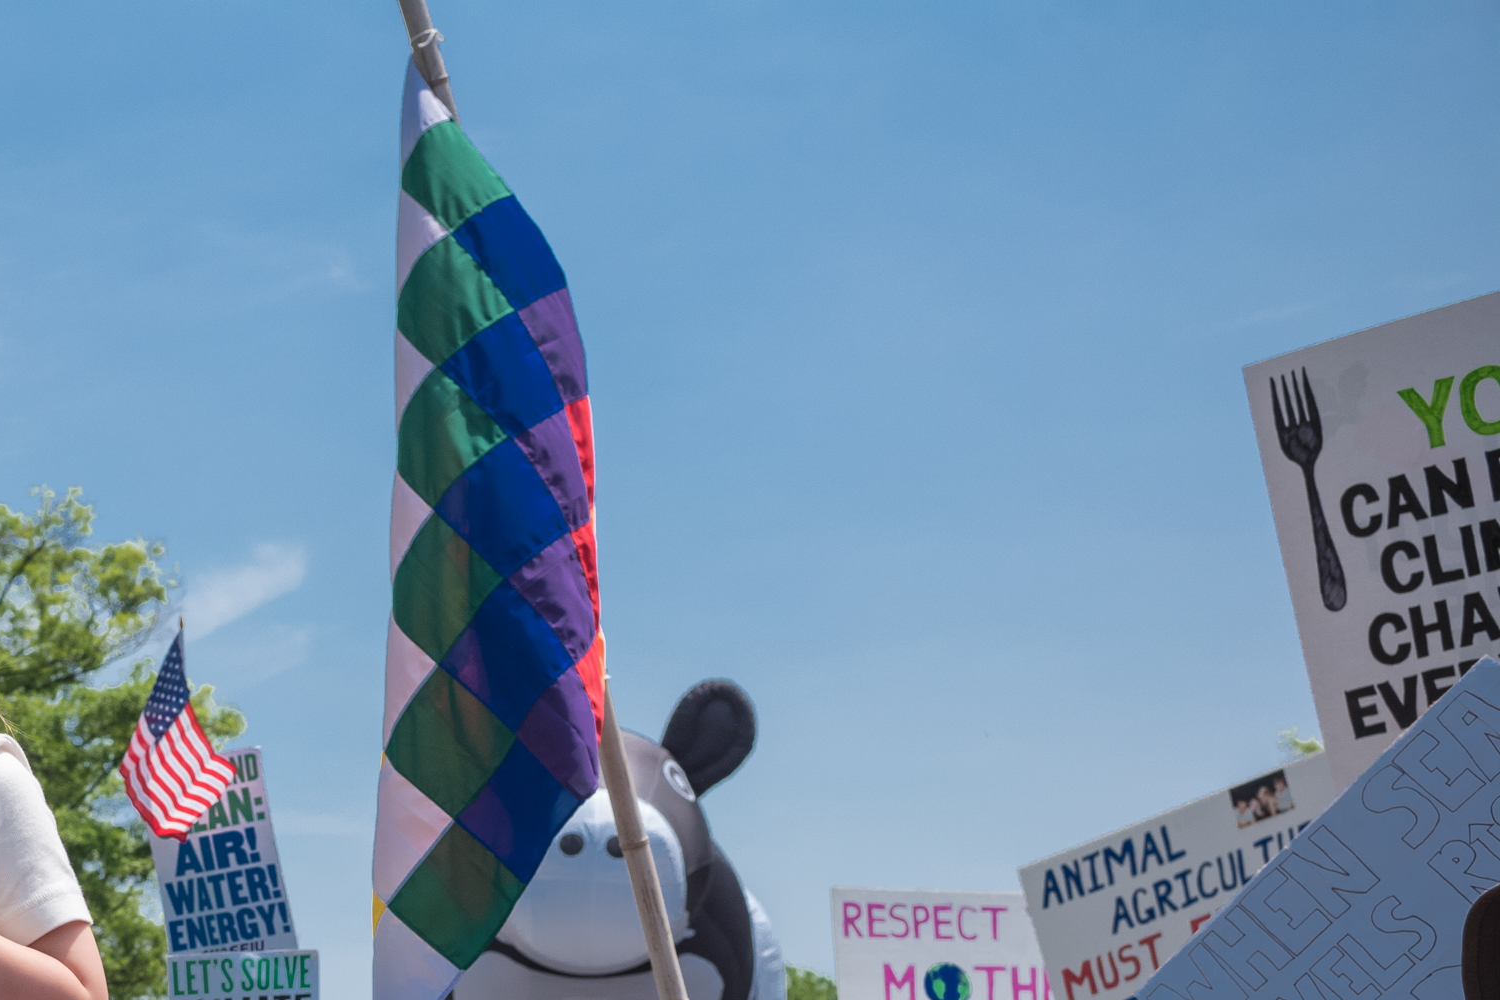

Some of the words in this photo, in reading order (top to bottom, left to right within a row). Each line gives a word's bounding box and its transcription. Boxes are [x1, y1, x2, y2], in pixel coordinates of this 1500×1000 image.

[1397, 365, 1500, 449] YO
[1340, 457, 1476, 538] CAN
[1368, 591, 1500, 666] CHA
[229, 753, 260, 785] ND
[175, 827, 261, 878] AIR!
[1042, 824, 1186, 910] ANIMAL
[165, 864, 282, 917] WATER!
[168, 902, 292, 953] ENERGY!
[843, 902, 1008, 941] RESPECT
[172, 958, 234, 996] LET'S
[241, 955, 311, 991] SOLVE
